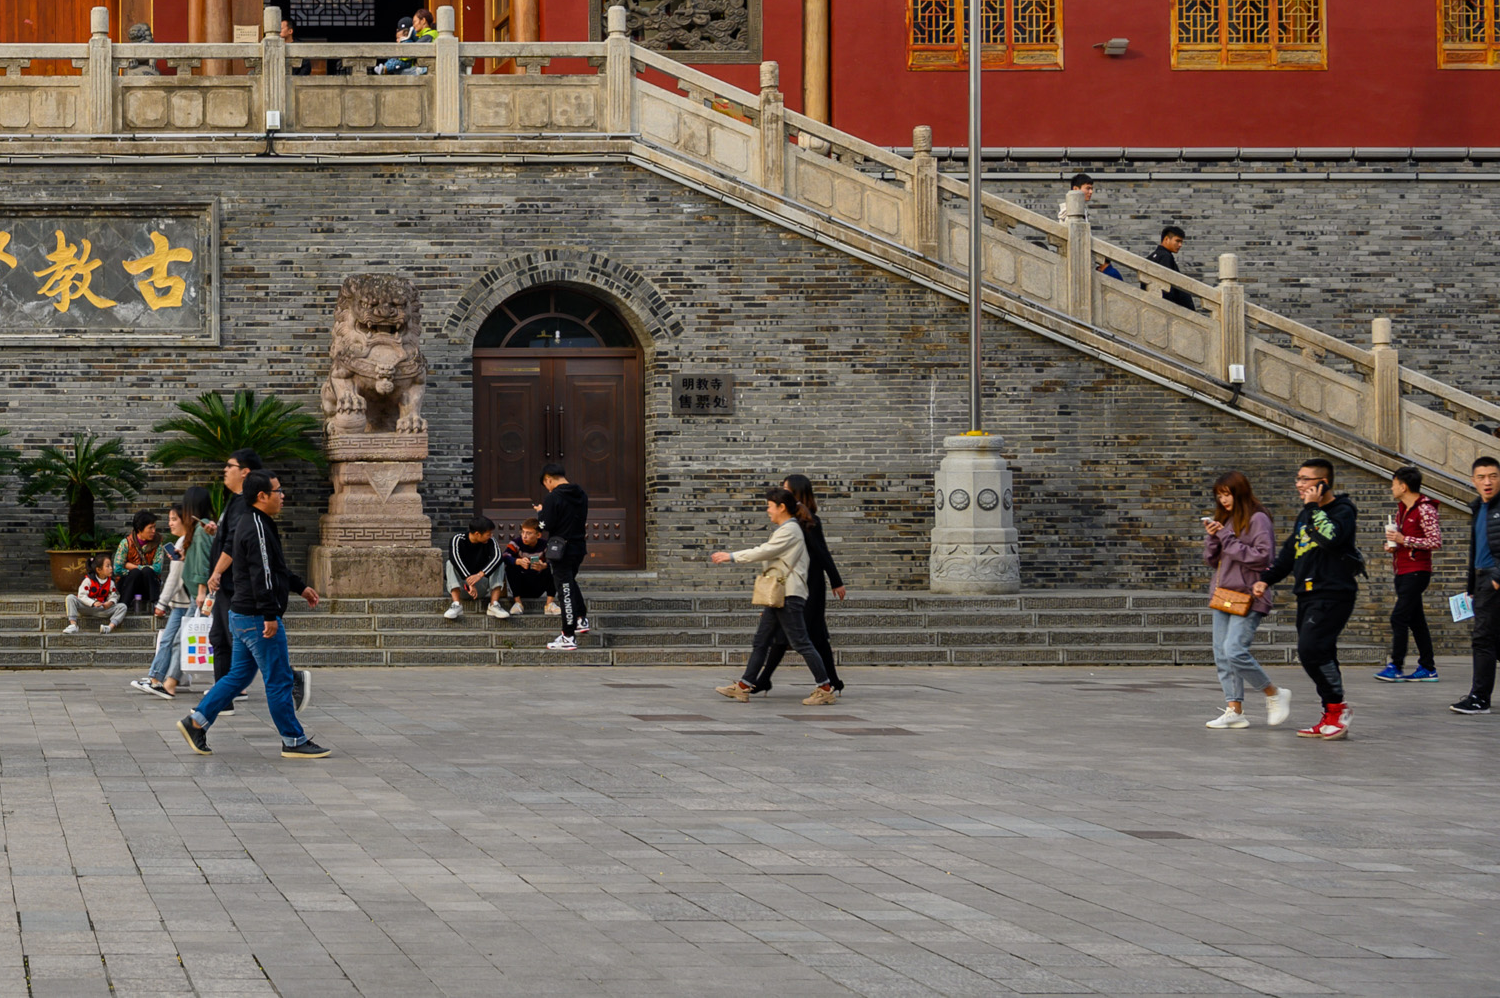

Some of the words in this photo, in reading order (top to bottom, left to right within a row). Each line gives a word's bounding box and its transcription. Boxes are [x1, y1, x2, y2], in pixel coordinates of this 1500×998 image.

[682, 377, 722, 391] 明教寺
[678, 394, 728, 409] 售票处
